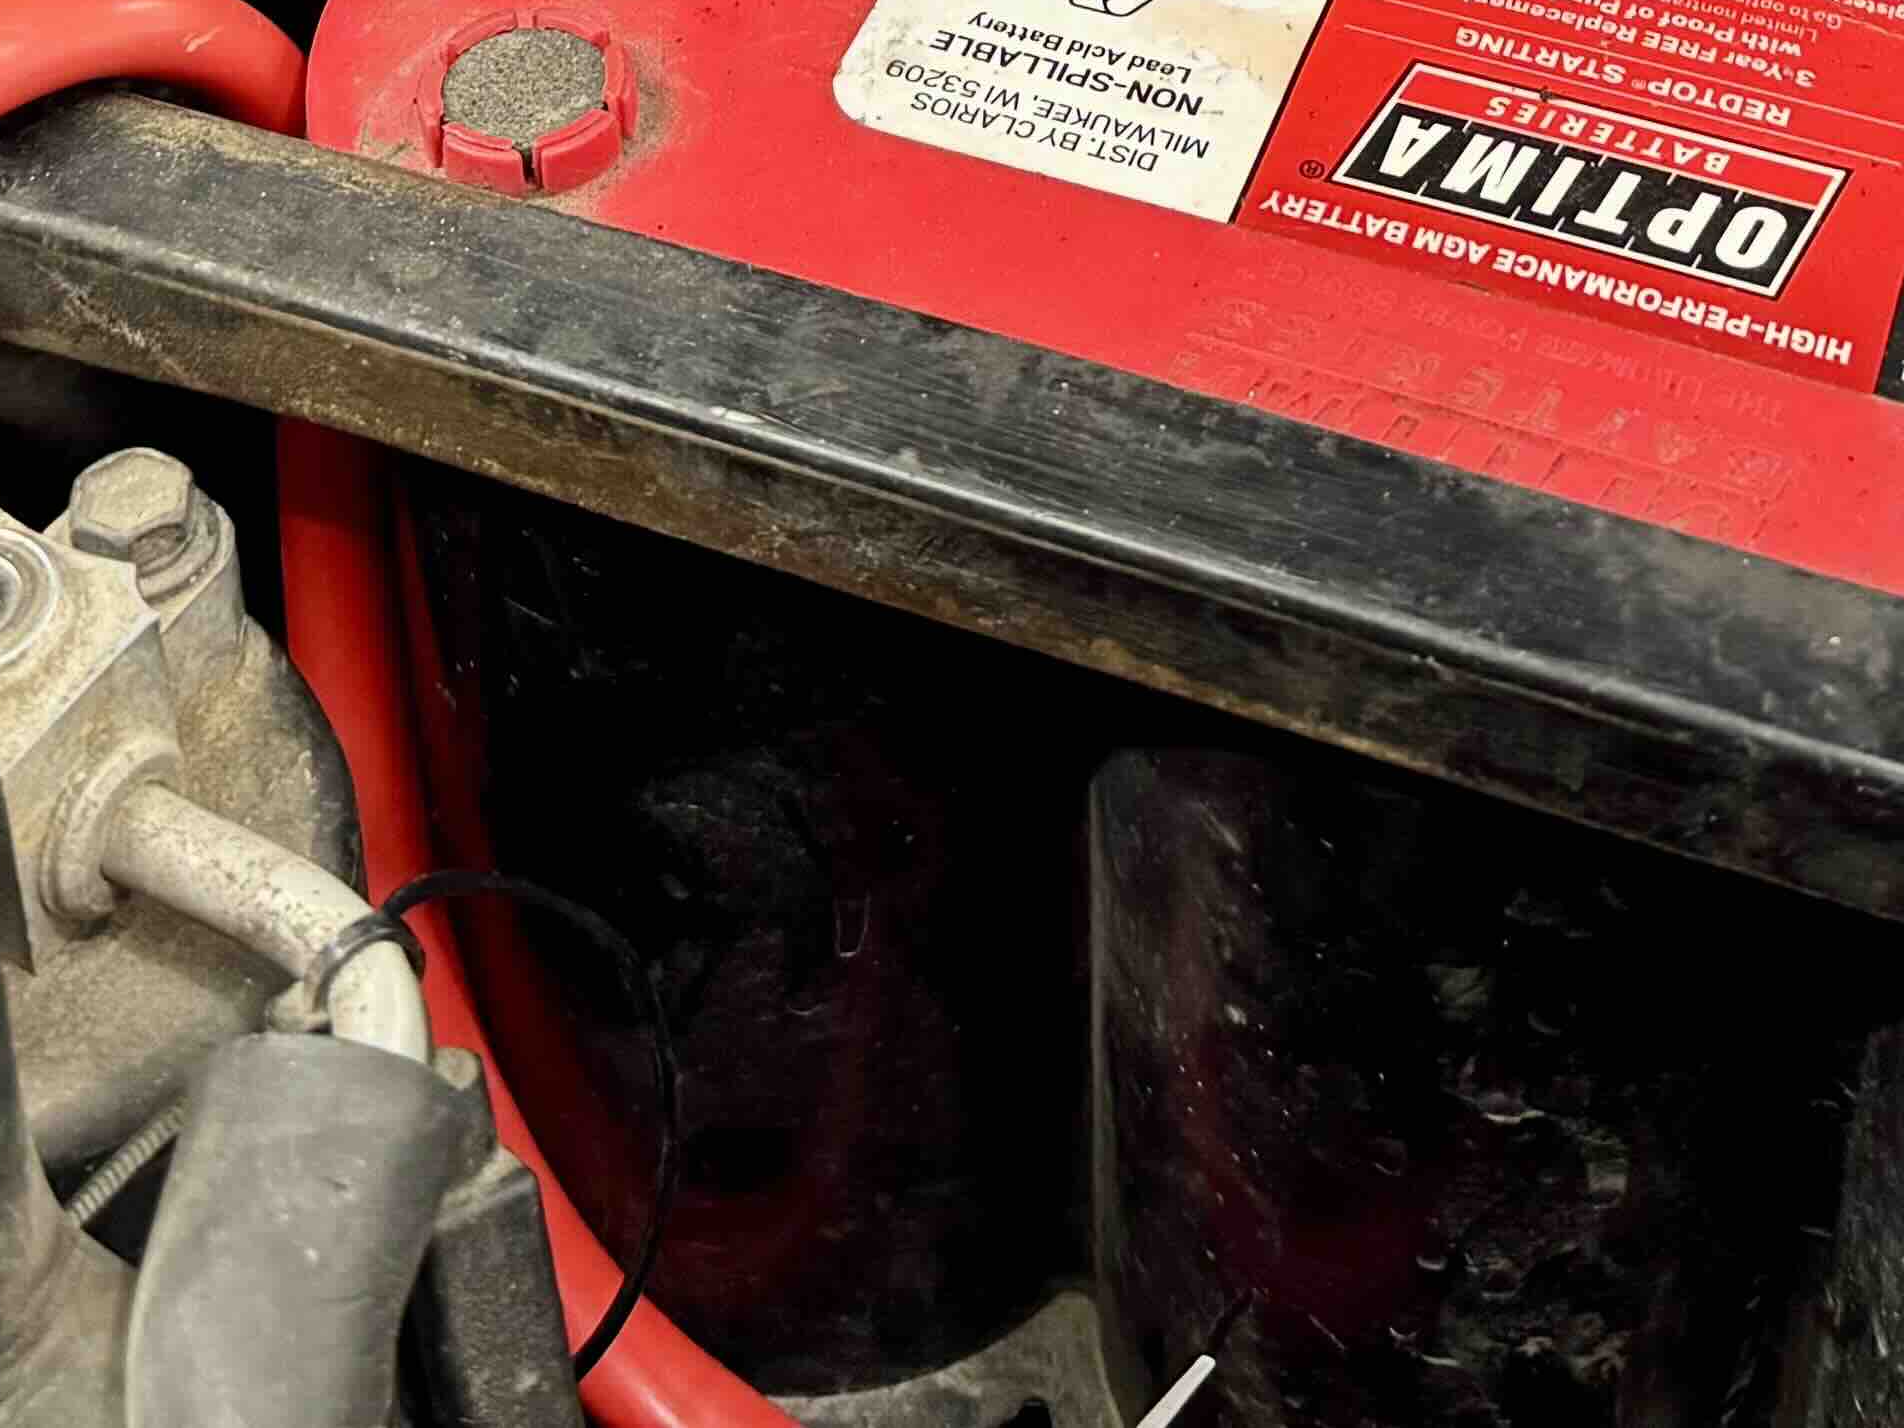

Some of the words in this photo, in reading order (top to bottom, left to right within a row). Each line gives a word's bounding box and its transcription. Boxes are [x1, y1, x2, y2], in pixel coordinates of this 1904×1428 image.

[964, 9, 1067, 51] Battery
[1622, 2, 1655, 24] of
[1656, 10, 1736, 43] Proof
[1739, 10, 1819, 41] Limited
[1786, 4, 1811, 21] to
[1809, 7, 1845, 30] Go
[1064, 38, 1126, 67] Acid
[1451, 25, 1628, 86] STARTING
[1638, 29, 1719, 63] FREE
[1738, 30, 1804, 59] with
[882, 57, 983, 98] 53209
[927, 27, 1205, 117] NON-SPILLABLE
[1126, 53, 1192, 84] Lead
[1719, 49, 1817, 88] 3-Year
[907, 90, 1039, 140] CLARIOS
[982, 84, 1023, 109] WI
[1024, 93, 1211, 160] MILWAUKEE,
[1036, 124, 1082, 151] BY
[1480, 92, 1731, 176] BATTERIES
[1081, 135, 1160, 173] DIST.
[1373, 109, 1793, 277] OPTIMA
[1258, 185, 1412, 247] BATTERY
[1409, 225, 1491, 267] AGM
[1489, 245, 1853, 365] HIGH-PERFORMANCE
